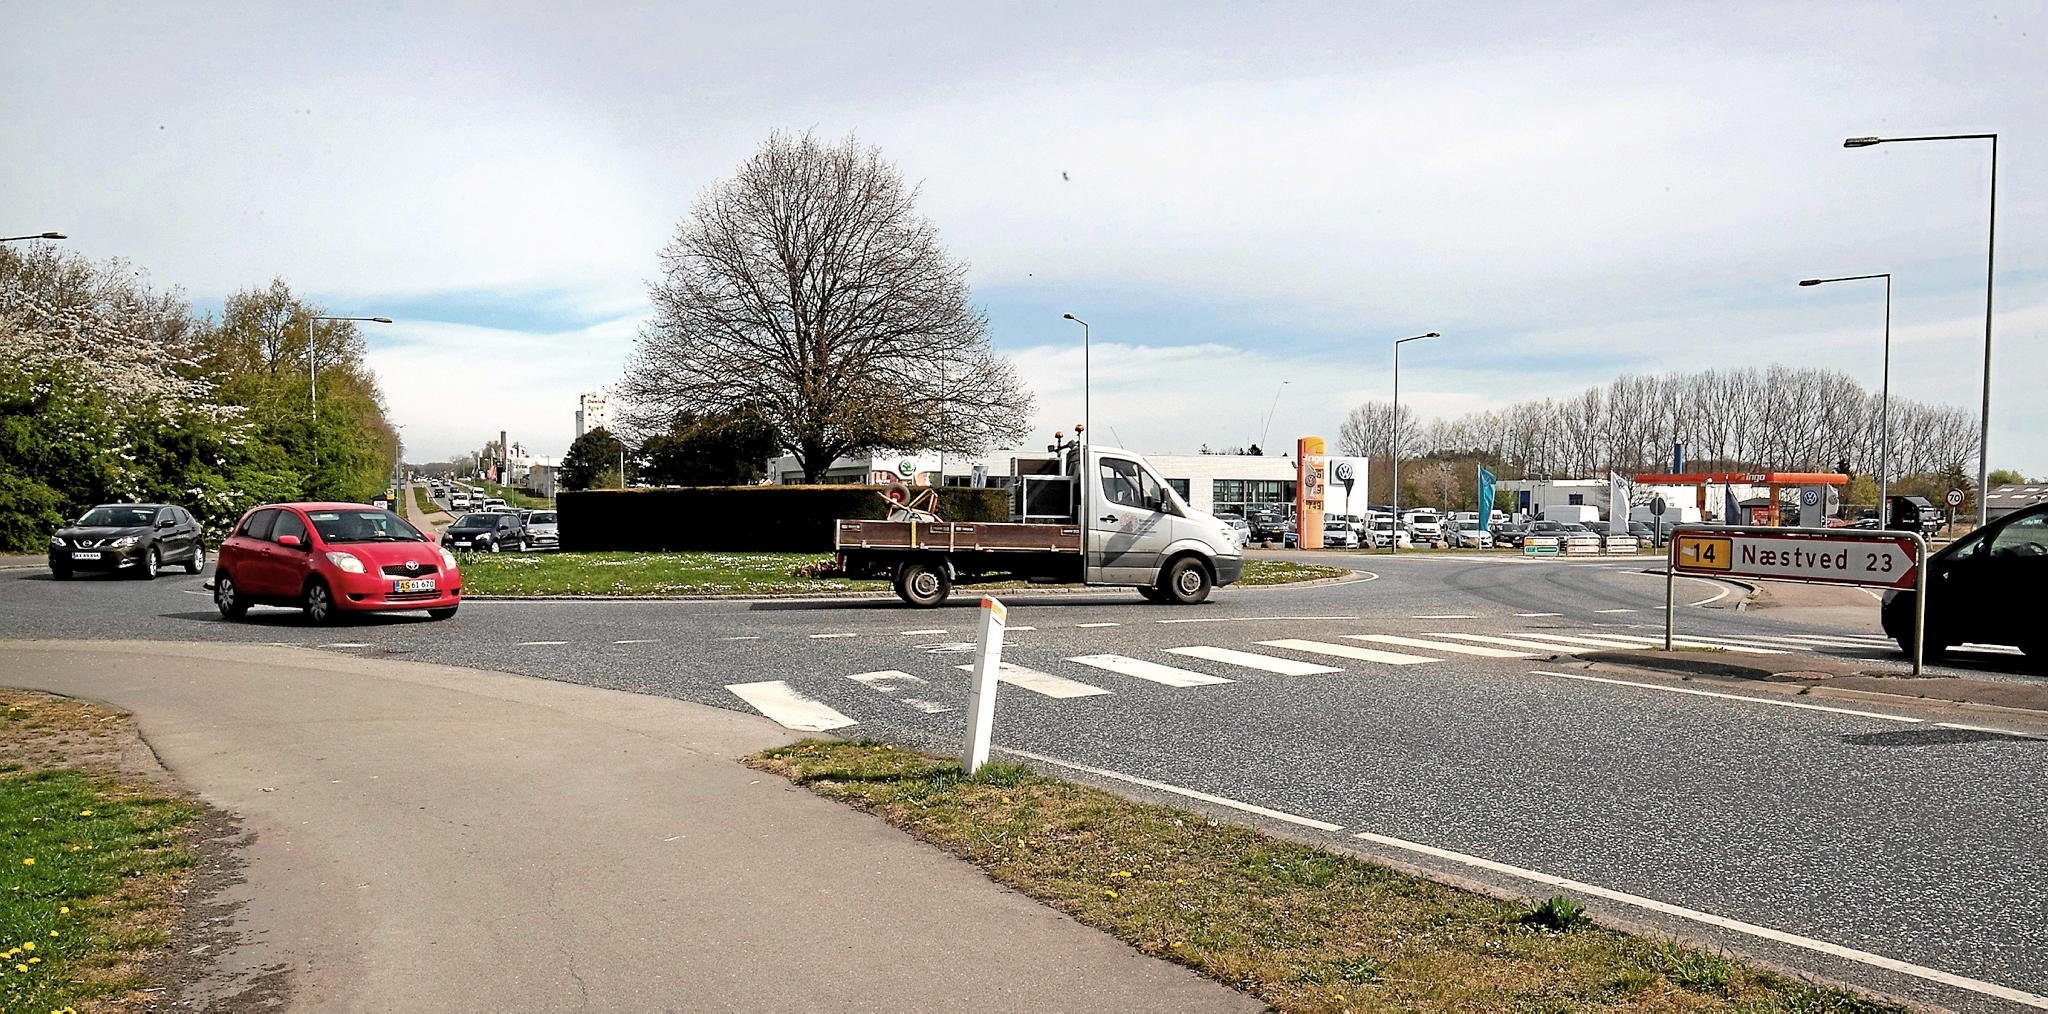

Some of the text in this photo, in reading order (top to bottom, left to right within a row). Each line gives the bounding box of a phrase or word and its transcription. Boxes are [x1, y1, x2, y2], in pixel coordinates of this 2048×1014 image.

[1745, 472, 1766, 482] ingo
[1949, 494, 1961, 502] 70
[1693, 543, 1894, 572] 14 Næstved 23
[400, 582, 410, 590] AS
[421, 580, 434, 588] 670
